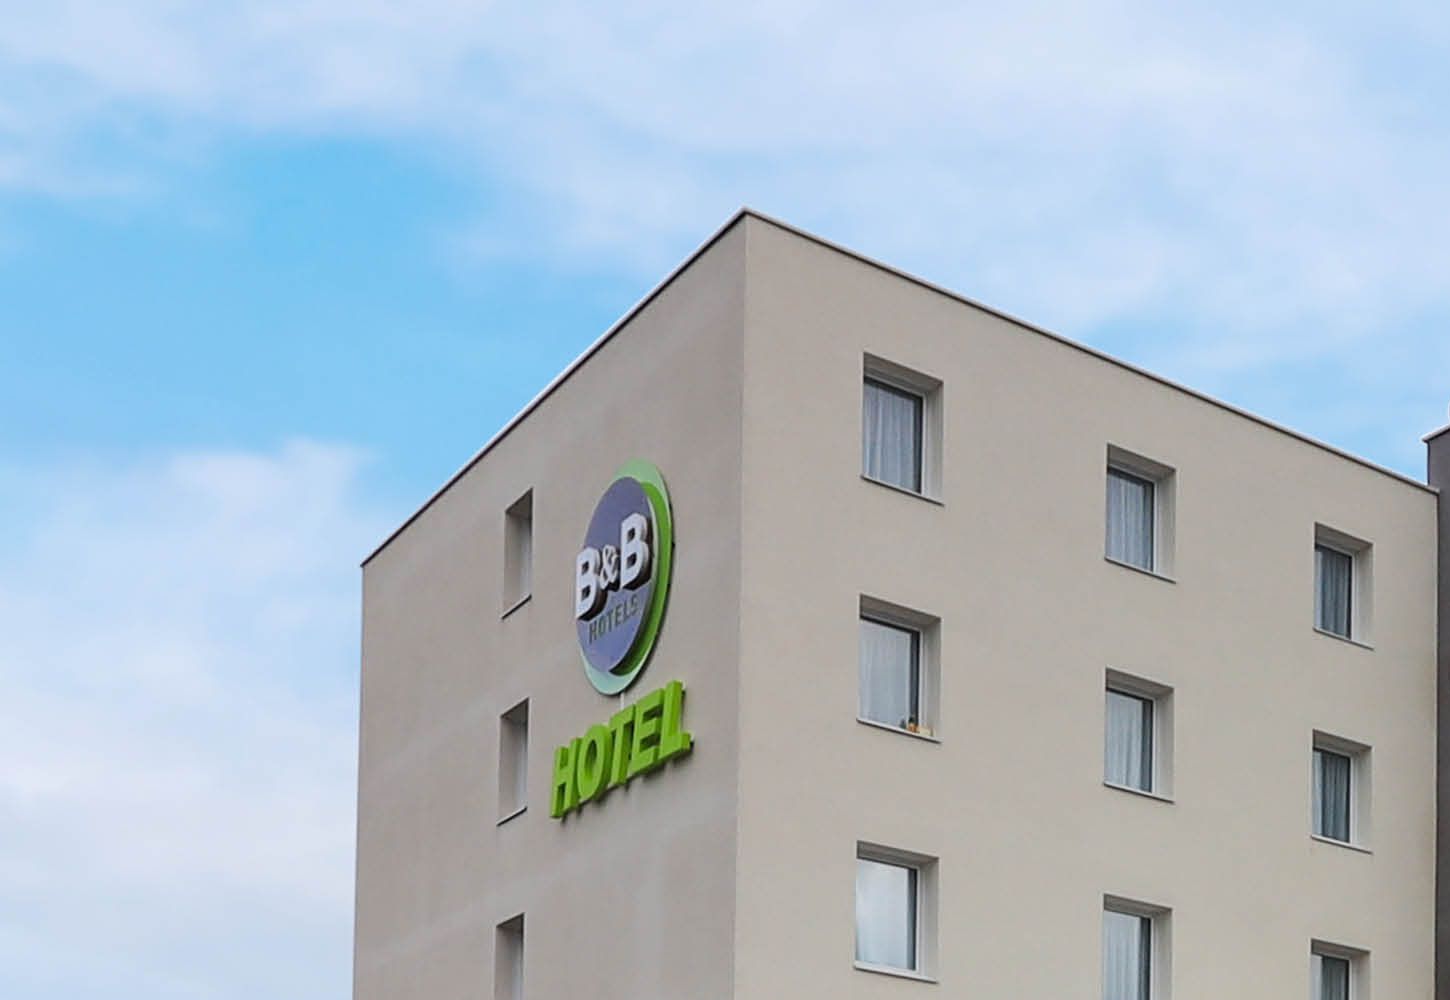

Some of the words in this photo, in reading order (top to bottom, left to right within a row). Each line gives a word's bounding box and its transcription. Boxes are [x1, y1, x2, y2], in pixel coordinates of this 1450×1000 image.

[576, 513, 653, 622] B&B
[589, 594, 641, 645] HOTELS
[550, 680, 694, 819] HOTEL
